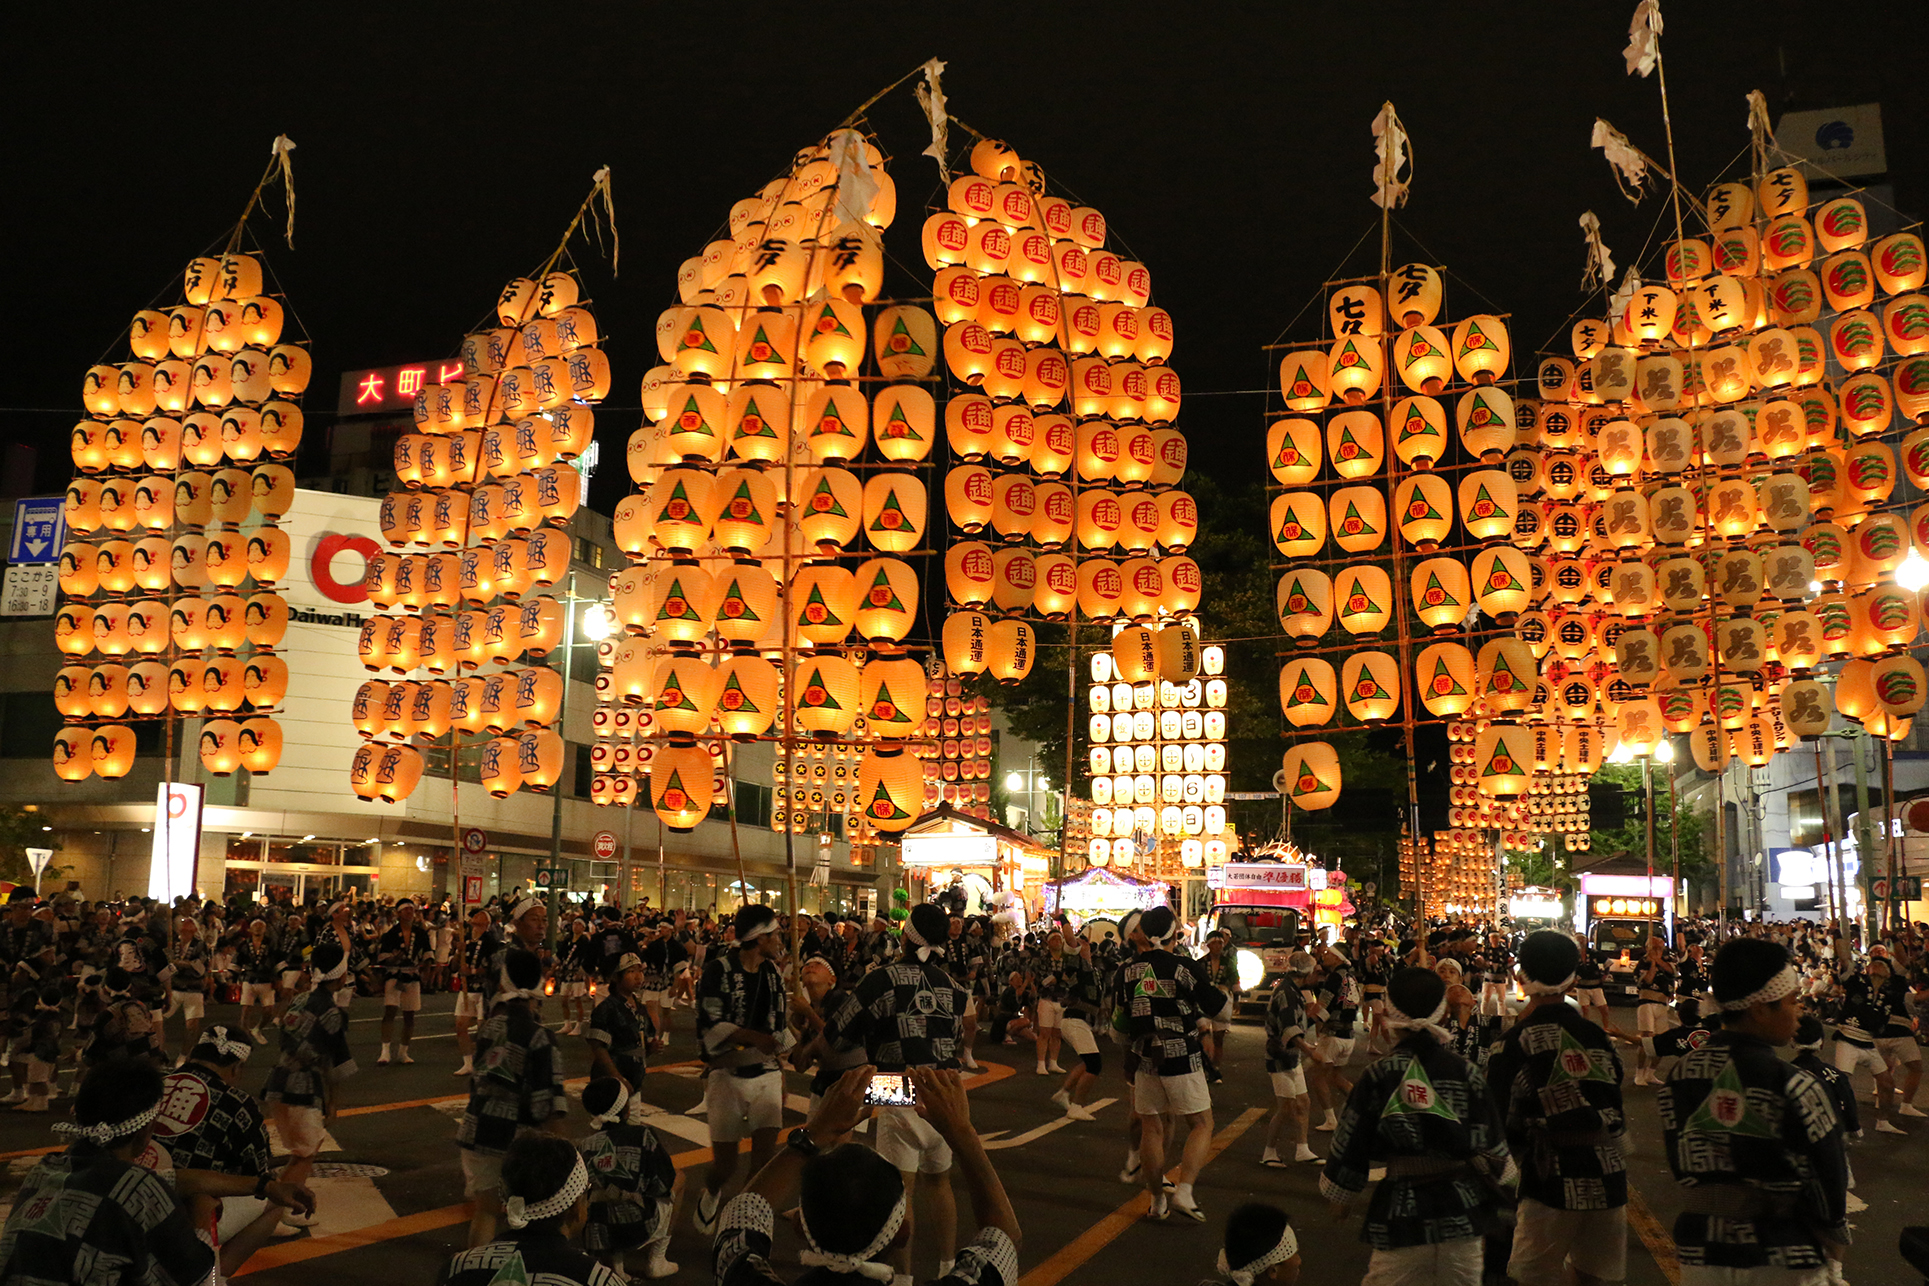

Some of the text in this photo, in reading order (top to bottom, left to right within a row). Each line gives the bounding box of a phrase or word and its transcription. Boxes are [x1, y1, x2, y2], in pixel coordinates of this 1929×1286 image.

[967, 184, 993, 209] 通
[1770, 172, 1795, 208] 七夕
[1005, 192, 1029, 218] 通
[1048, 205, 1071, 230] 通
[1711, 187, 1733, 225] 七夕
[939, 222, 967, 248] 通
[1084, 215, 1102, 238] 通
[983, 230, 1009, 256] 通
[1025, 237, 1049, 261] 通
[754, 237, 788, 276] 七夕
[1064, 250, 1086, 275] 通
[186, 259, 203, 292] 七夕
[221, 260, 237, 297] 七夕
[1098, 258, 1120, 282] 通
[1130, 270, 1147, 294] 通
[540, 276, 568, 311] 七夕
[951, 277, 978, 303] 通
[1398, 265, 1429, 305] 七夕
[992, 286, 1020, 312] 通
[1031, 296, 1057, 322] 通
[1075, 308, 1099, 333] 通
[1115, 312, 1138, 337] 通
[1151, 314, 1171, 338] 通
[1336, 296, 1365, 335] 七夕
[964, 326, 993, 351] 通
[1579, 326, 1599, 352] 七夕
[998, 350, 1025, 376] 通
[1039, 359, 1065, 385] 通
[1086, 365, 1110, 391] 通
[1125, 372, 1147, 398] 通
[1158, 374, 1180, 400] 通
[965, 404, 993, 430] 通
[1007, 417, 1034, 443] 通
[1048, 426, 1072, 452] 通
[1093, 433, 1118, 459] 通
[1131, 436, 1154, 461] 通
[1163, 440, 1185, 466] 通
[966, 475, 993, 502] 通
[1007, 485, 1035, 512] 通
[1047, 493, 1071, 520] 通
[1093, 501, 1120, 527] 通
[1134, 503, 1158, 529] 通
[1173, 499, 1196, 524] 通
[9, 571, 54, 583] ここから
[964, 552, 993, 578] 通
[1007, 559, 1035, 585] 通
[1049, 565, 1076, 591] 通
[1174, 564, 1199, 589] 通
[1094, 570, 1121, 596] 通
[1135, 568, 1161, 594] 通
[288, 606, 343, 626] Daiwa
[970, 616, 984, 662] 日本通運
[1012, 627, 1028, 671] 日本通運
[1140, 631, 1154, 672] 日本通運
[1181, 631, 1195, 672] 日本通運
[1263, 871, 1303, 884] 準優勝
[1407, 1084, 1428, 1104] 保
